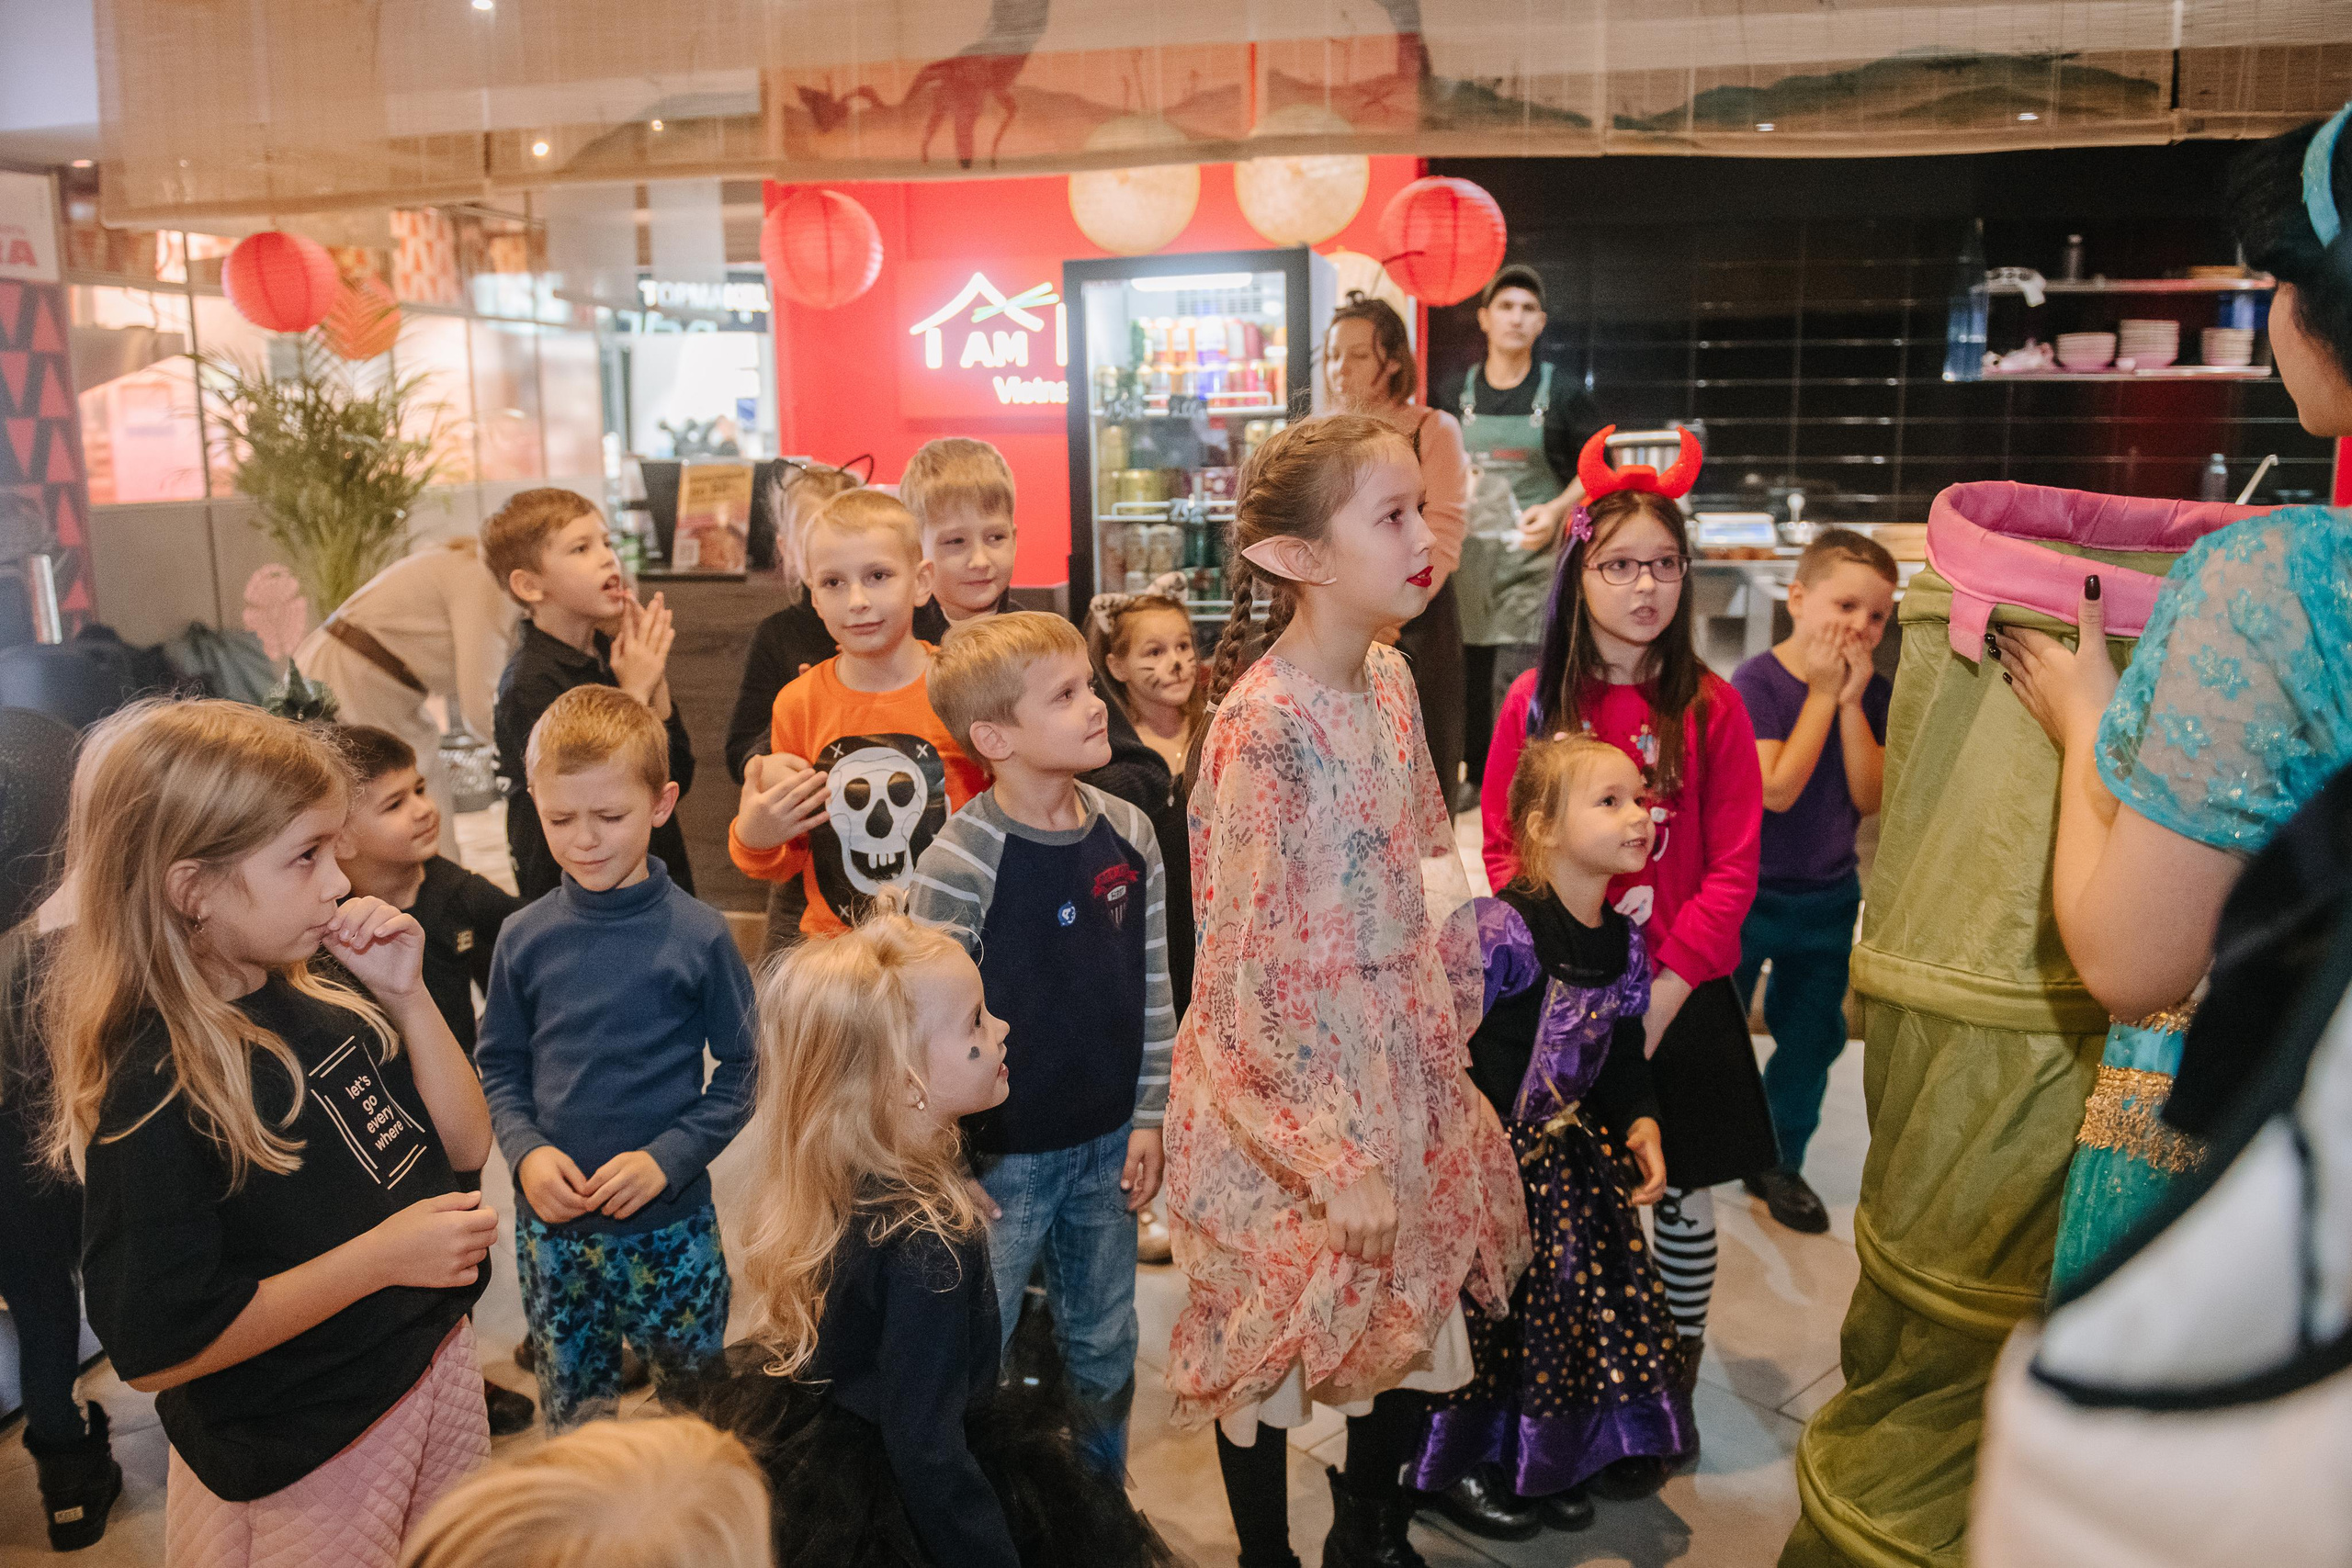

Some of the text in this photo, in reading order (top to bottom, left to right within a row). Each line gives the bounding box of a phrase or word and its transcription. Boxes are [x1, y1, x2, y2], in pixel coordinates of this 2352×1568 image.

[960, 330, 1028, 368] AM
[345, 1075, 372, 1100] let's
[362, 1095, 378, 1115] go
[367, 1105, 394, 1134] every
[375, 1120, 404, 1151] where
